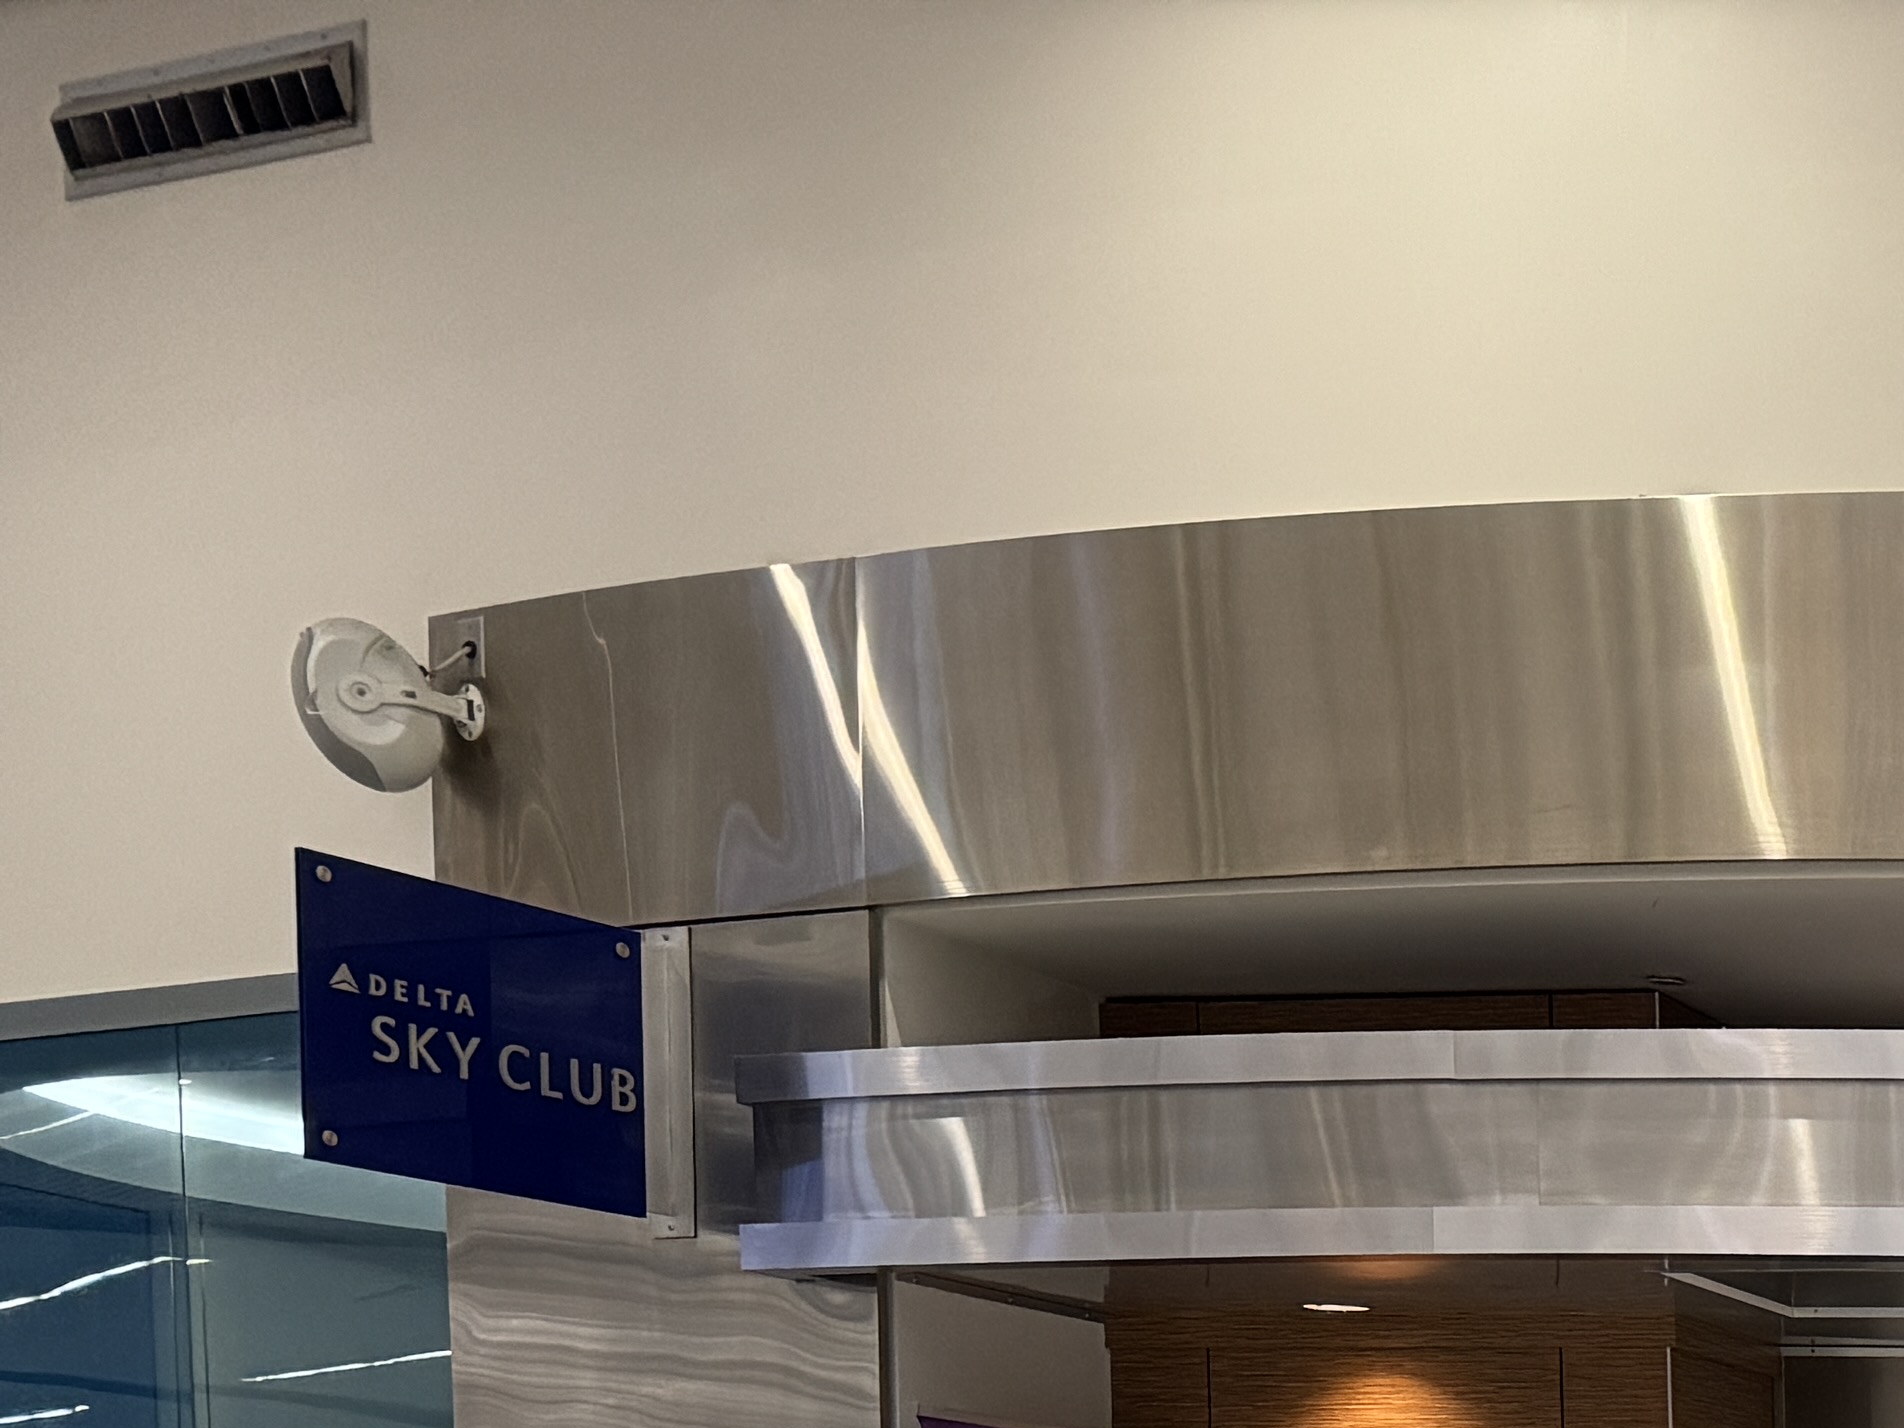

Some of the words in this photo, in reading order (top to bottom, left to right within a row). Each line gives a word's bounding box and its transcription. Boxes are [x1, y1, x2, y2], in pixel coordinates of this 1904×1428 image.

[368, 973, 475, 1017] DELTA
[371, 1015, 481, 1080] SKY
[498, 1044, 638, 1113] CLUB
